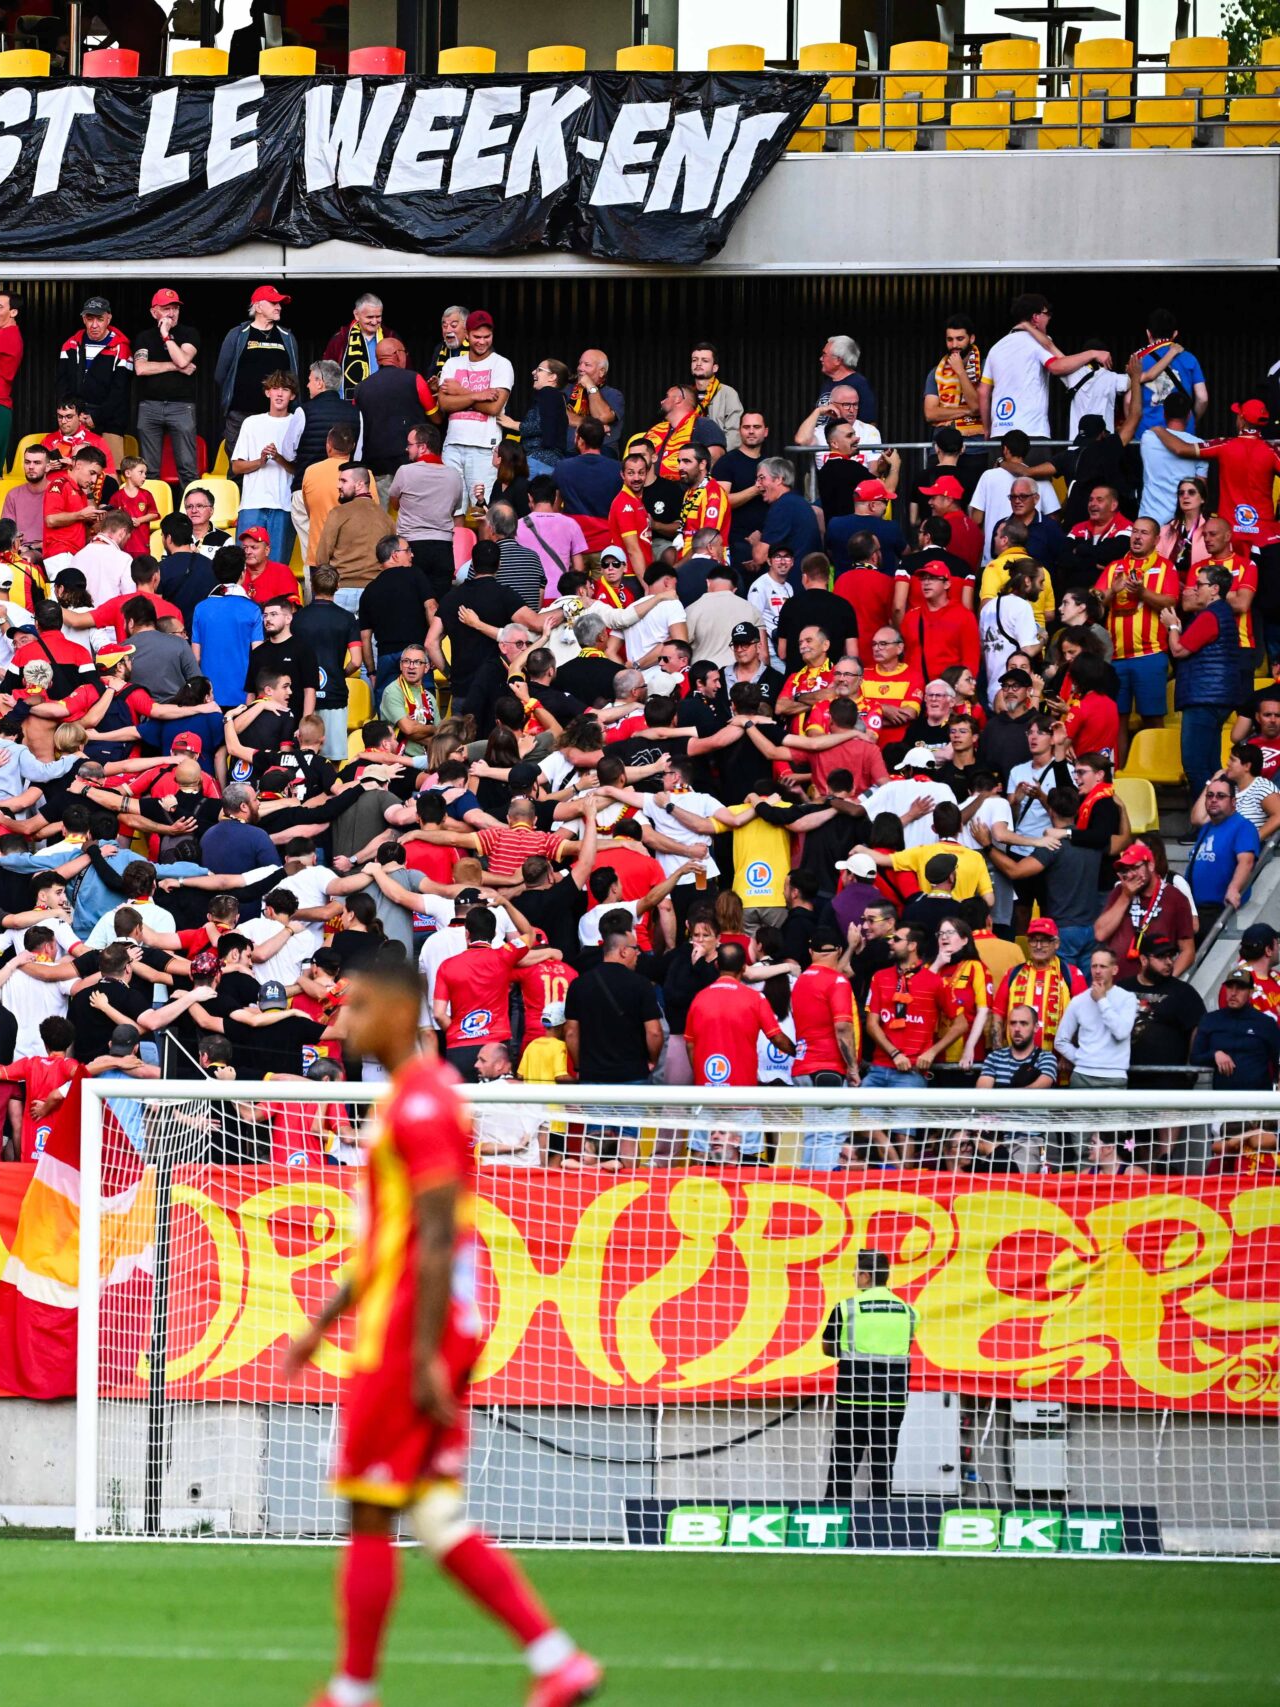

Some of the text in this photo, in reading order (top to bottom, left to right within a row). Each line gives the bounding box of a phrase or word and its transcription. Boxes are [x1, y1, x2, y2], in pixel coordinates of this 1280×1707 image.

[138, 75, 264, 196] LE
[541, 974, 568, 1004] 10
[670, 1512, 844, 1544] BKT
[943, 1517, 1117, 1549] BKT
